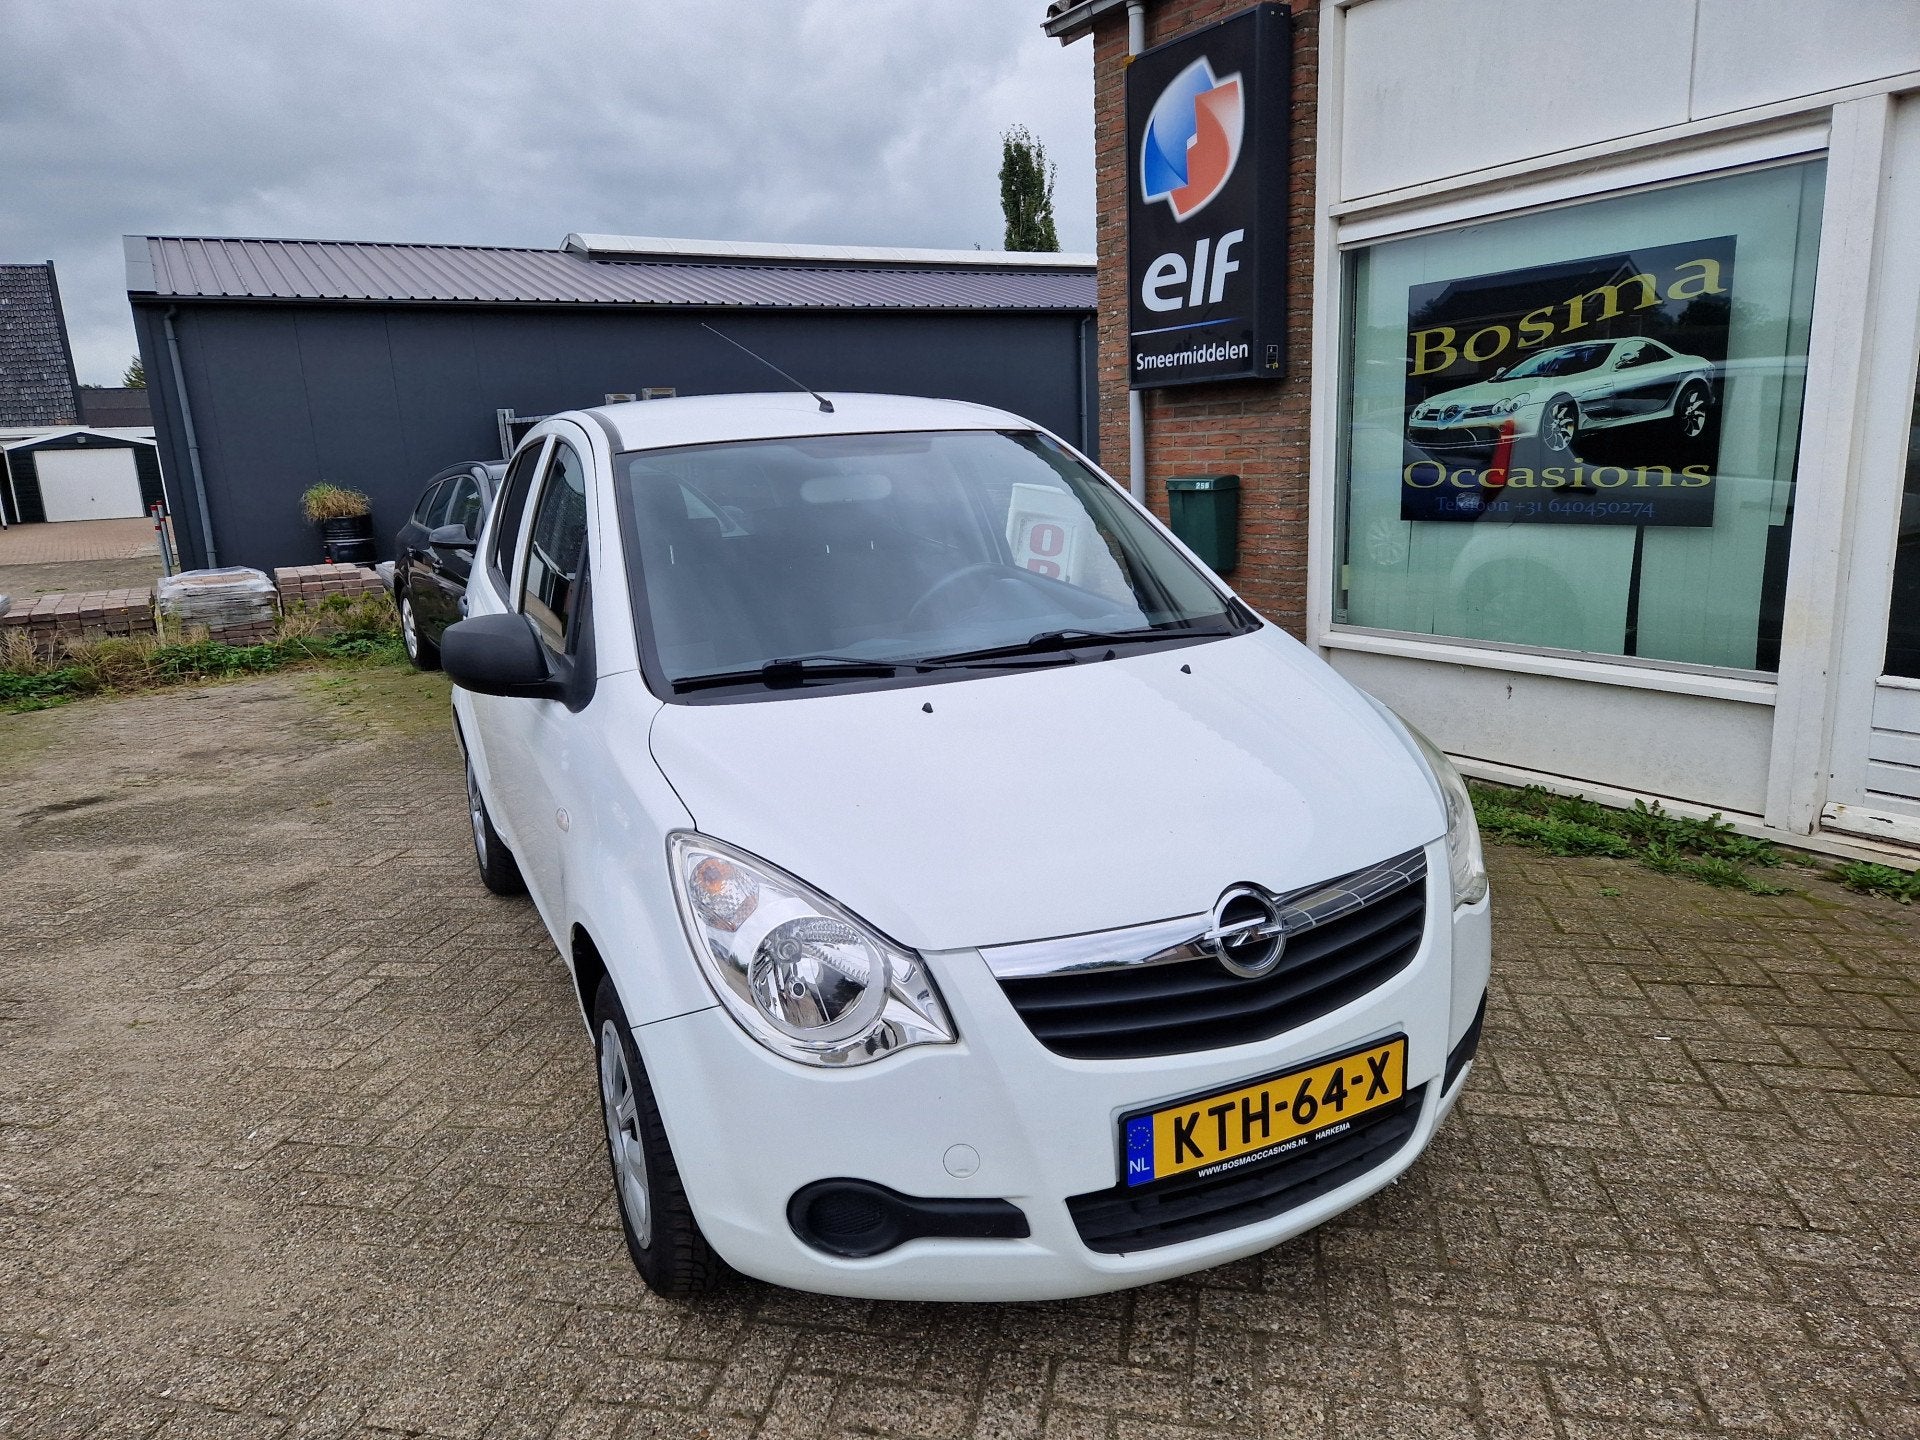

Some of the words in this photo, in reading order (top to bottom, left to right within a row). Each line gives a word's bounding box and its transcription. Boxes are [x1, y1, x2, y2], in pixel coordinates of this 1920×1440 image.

[1141, 228, 1245, 313] elf
[1407, 258, 1728, 377] Bosma
[1136, 340, 1249, 372] Smeermiddelen
[1403, 457, 1712, 488] Occasions
[1515, 500, 1543, 517] +31
[1549, 497, 1655, 518] 640450274
[1129, 1156, 1151, 1175] NL
[1173, 1050, 1391, 1164] KTH-64-X
[1198, 1137, 1309, 1178] WWW.BOSMAOCCASIONS.NL
[1315, 1122, 1351, 1141] HARKEMA
